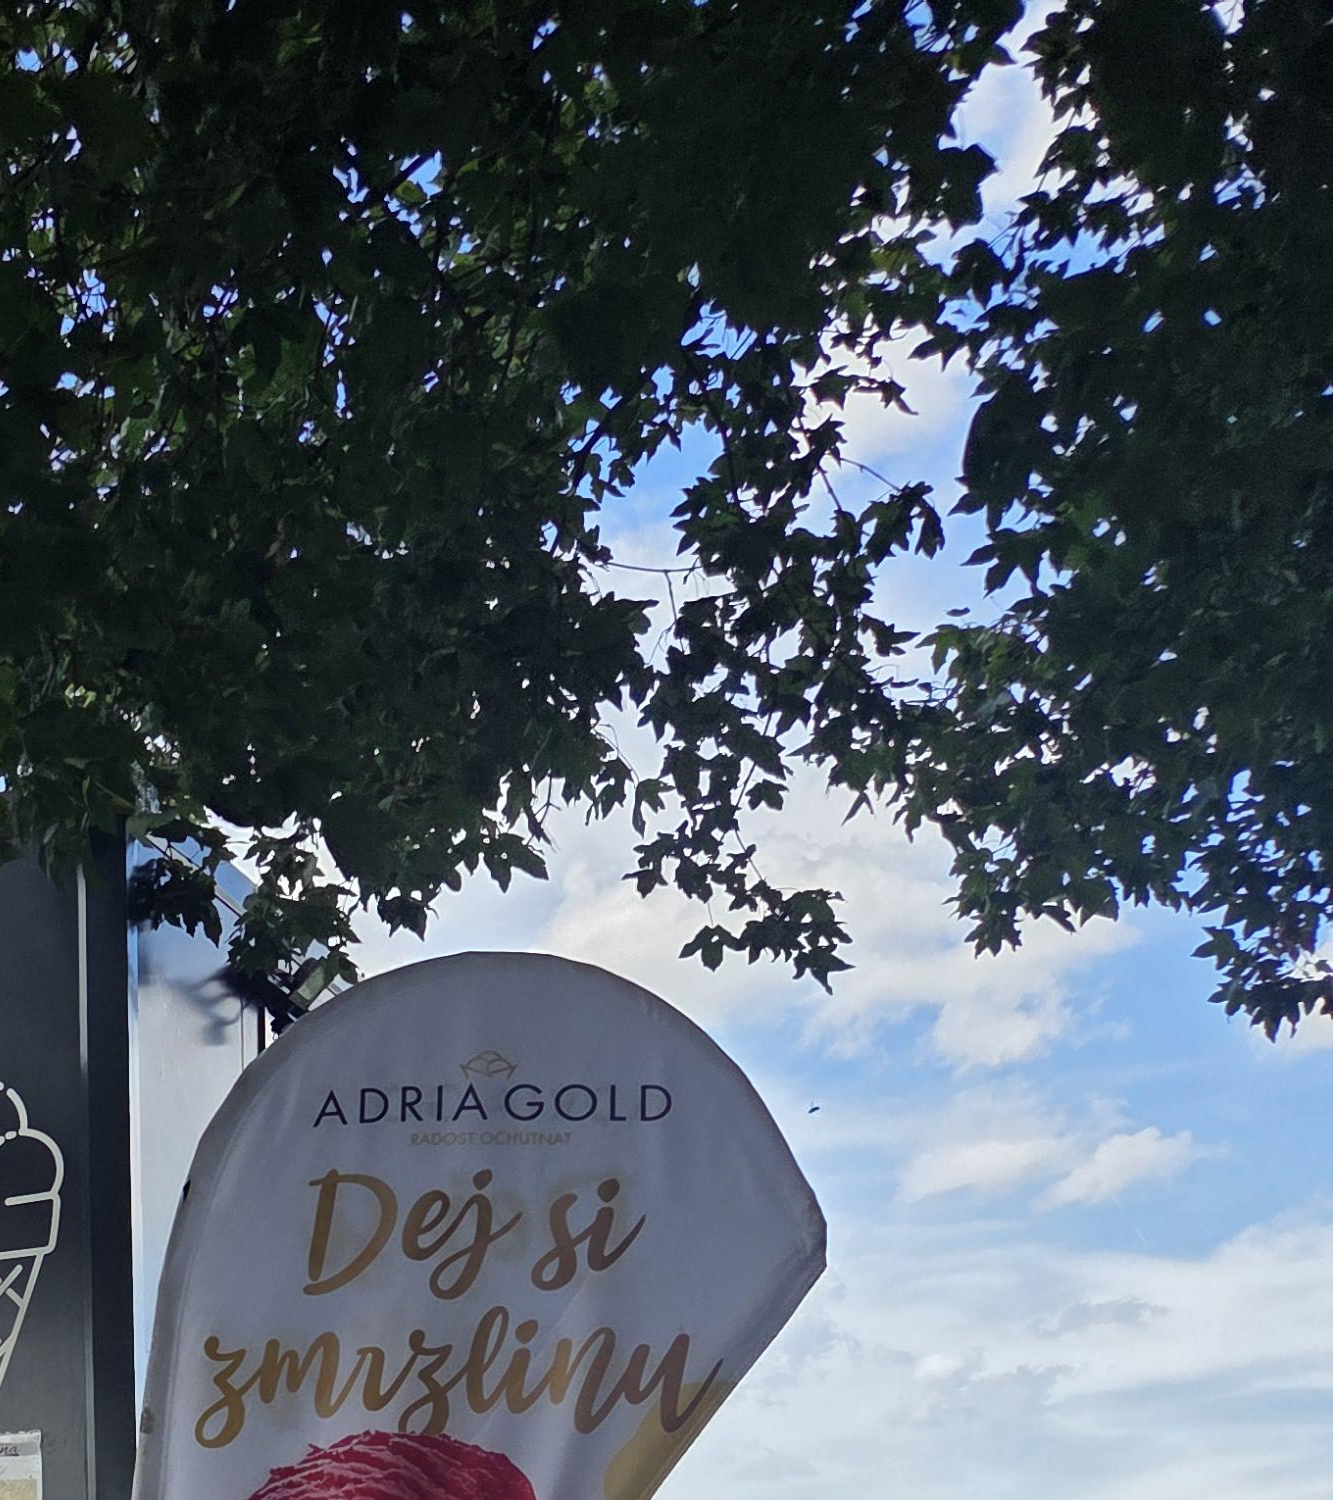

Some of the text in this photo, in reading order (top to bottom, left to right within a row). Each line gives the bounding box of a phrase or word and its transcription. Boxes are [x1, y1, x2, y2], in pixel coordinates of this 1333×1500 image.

[410, 1131, 474, 1146] RADOST
[303, 1168, 646, 1300] Dej si
[193, 1305, 725, 1450] zmrzlinu
